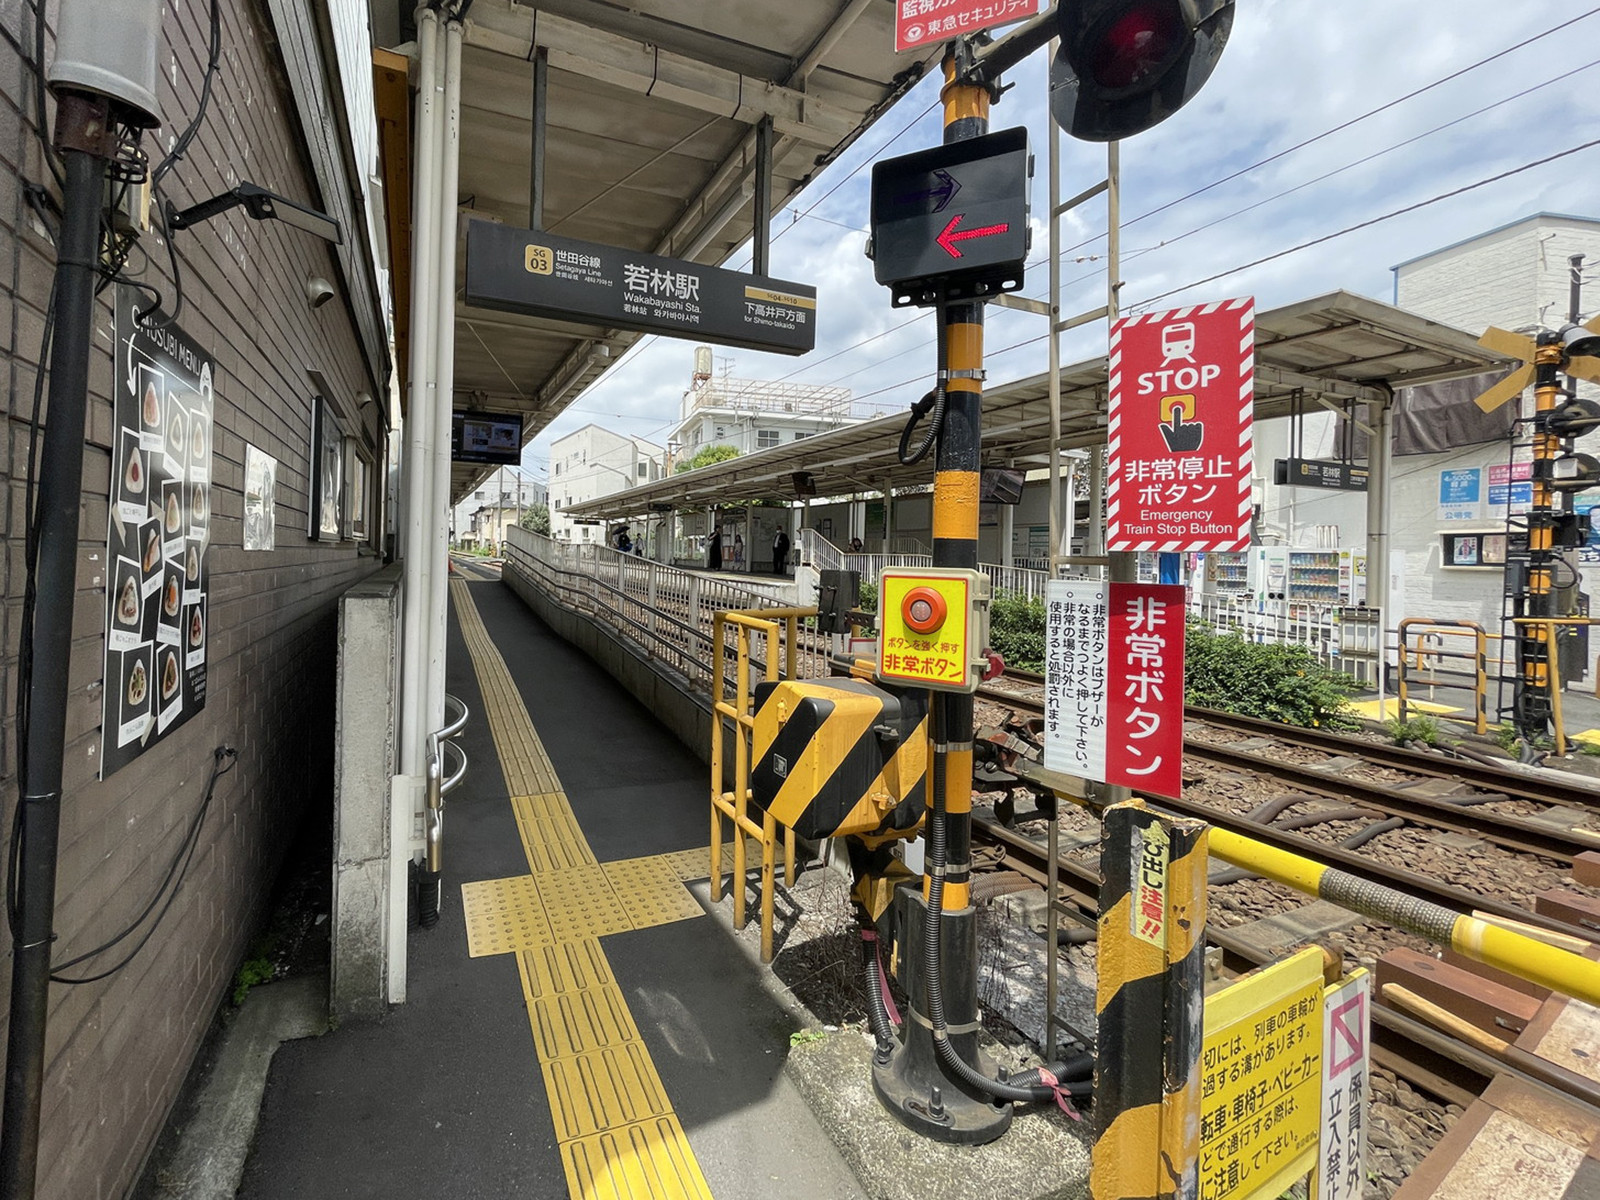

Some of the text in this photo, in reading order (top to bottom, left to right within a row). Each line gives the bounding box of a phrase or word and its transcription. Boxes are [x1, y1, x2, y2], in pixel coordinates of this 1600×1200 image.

[928, 0, 1029, 35] 東急セキュリティ
[530, 258, 548, 271] 03
[533, 248, 546, 258] SG
[555, 249, 601, 269] 世田谷線
[555, 262, 602, 277] Setagaya Line
[623, 263, 700, 302] 若林駅
[623, 291, 702, 314] Wakabayashi Sta.
[623, 303, 648, 316] 若林站
[744, 301, 806, 324] 下高井戸方面
[653, 309, 700, 324] 와카바야시역
[743, 315, 796, 330] for Shimo-takaido
[179, 343, 201, 377] MENU
[1137, 364, 1221, 395] STOP
[1125, 455, 1233, 483] 非常停止
[1138, 483, 1217, 506] ボタン
[1140, 508, 1214, 523] Emergency
[1123, 521, 1233, 537] Train Stop Button
[888, 637, 960, 655] ボタンを強く押す
[1062, 602, 1076, 699] 非常の場合以外に
[885, 653, 962, 678] 非常ボタン
[1047, 601, 1062, 739] 使用すると処罰されます。
[1090, 603, 1106, 728] 非常ボタンはブザーが
[1075, 603, 1091, 769] なるまでつよく押して下さい。
[1125, 596, 1167, 776] 非常ボタン
[1202, 1024, 1310, 1100] 過する溝があります。
[1326, 1087, 1343, 1200] 立入禁止
[1346, 1070, 1362, 1199] 係員以外
